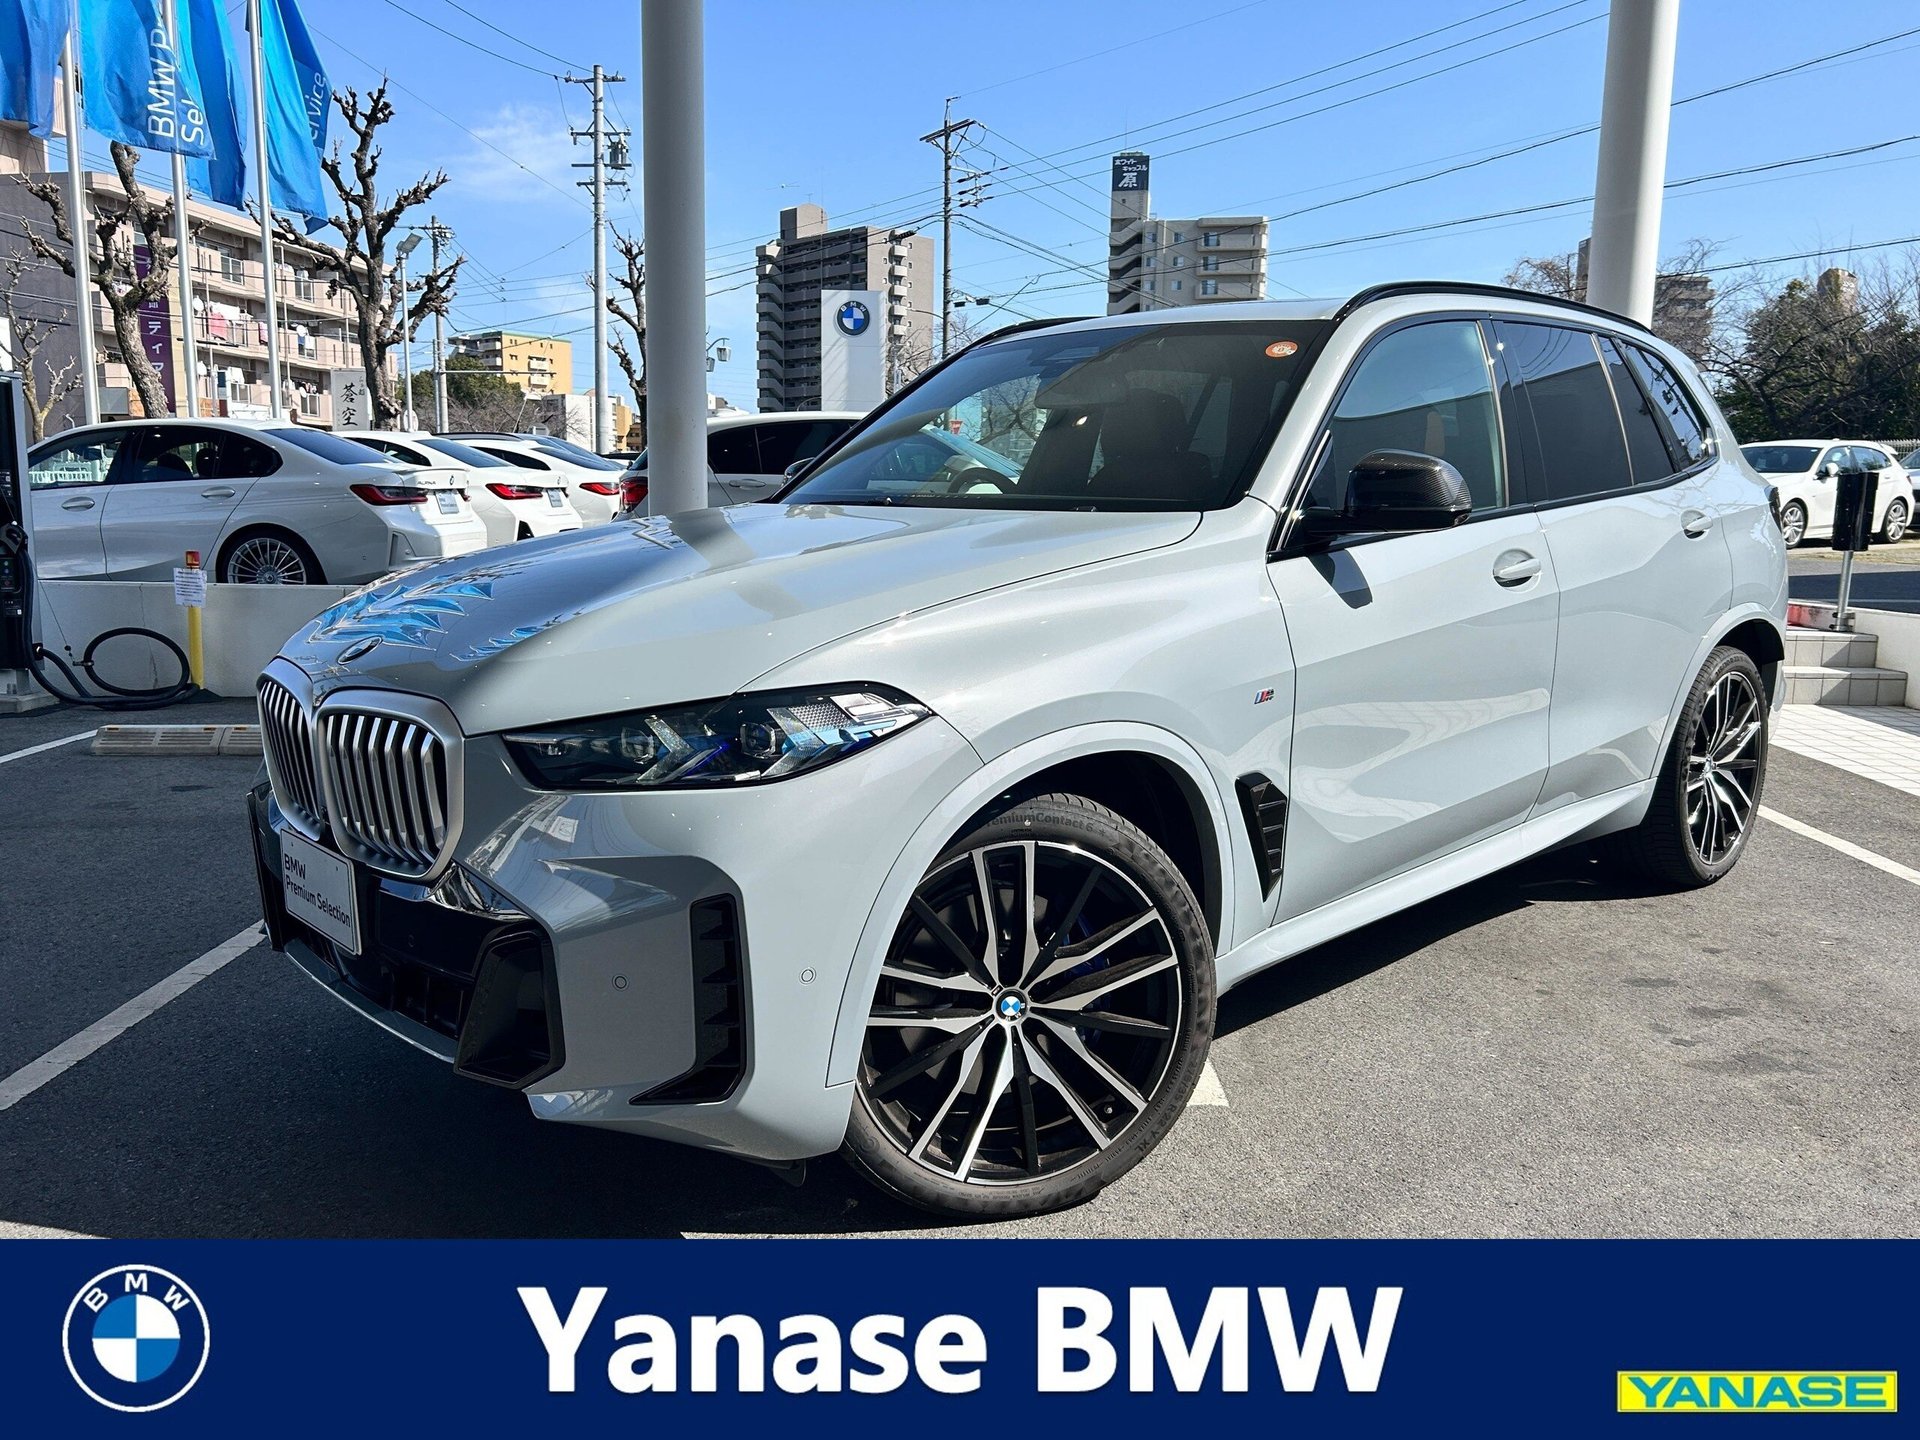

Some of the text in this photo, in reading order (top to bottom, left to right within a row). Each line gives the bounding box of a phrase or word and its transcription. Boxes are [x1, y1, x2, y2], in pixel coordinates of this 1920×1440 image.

[147, 57, 176, 138] BMW
[1118, 172, 1138, 188] 原
[840, 301, 867, 312] BMW
[340, 382, 358, 426] 蒼空
[284, 854, 306, 880] BMW
[285, 874, 351, 928] Premium Selection
